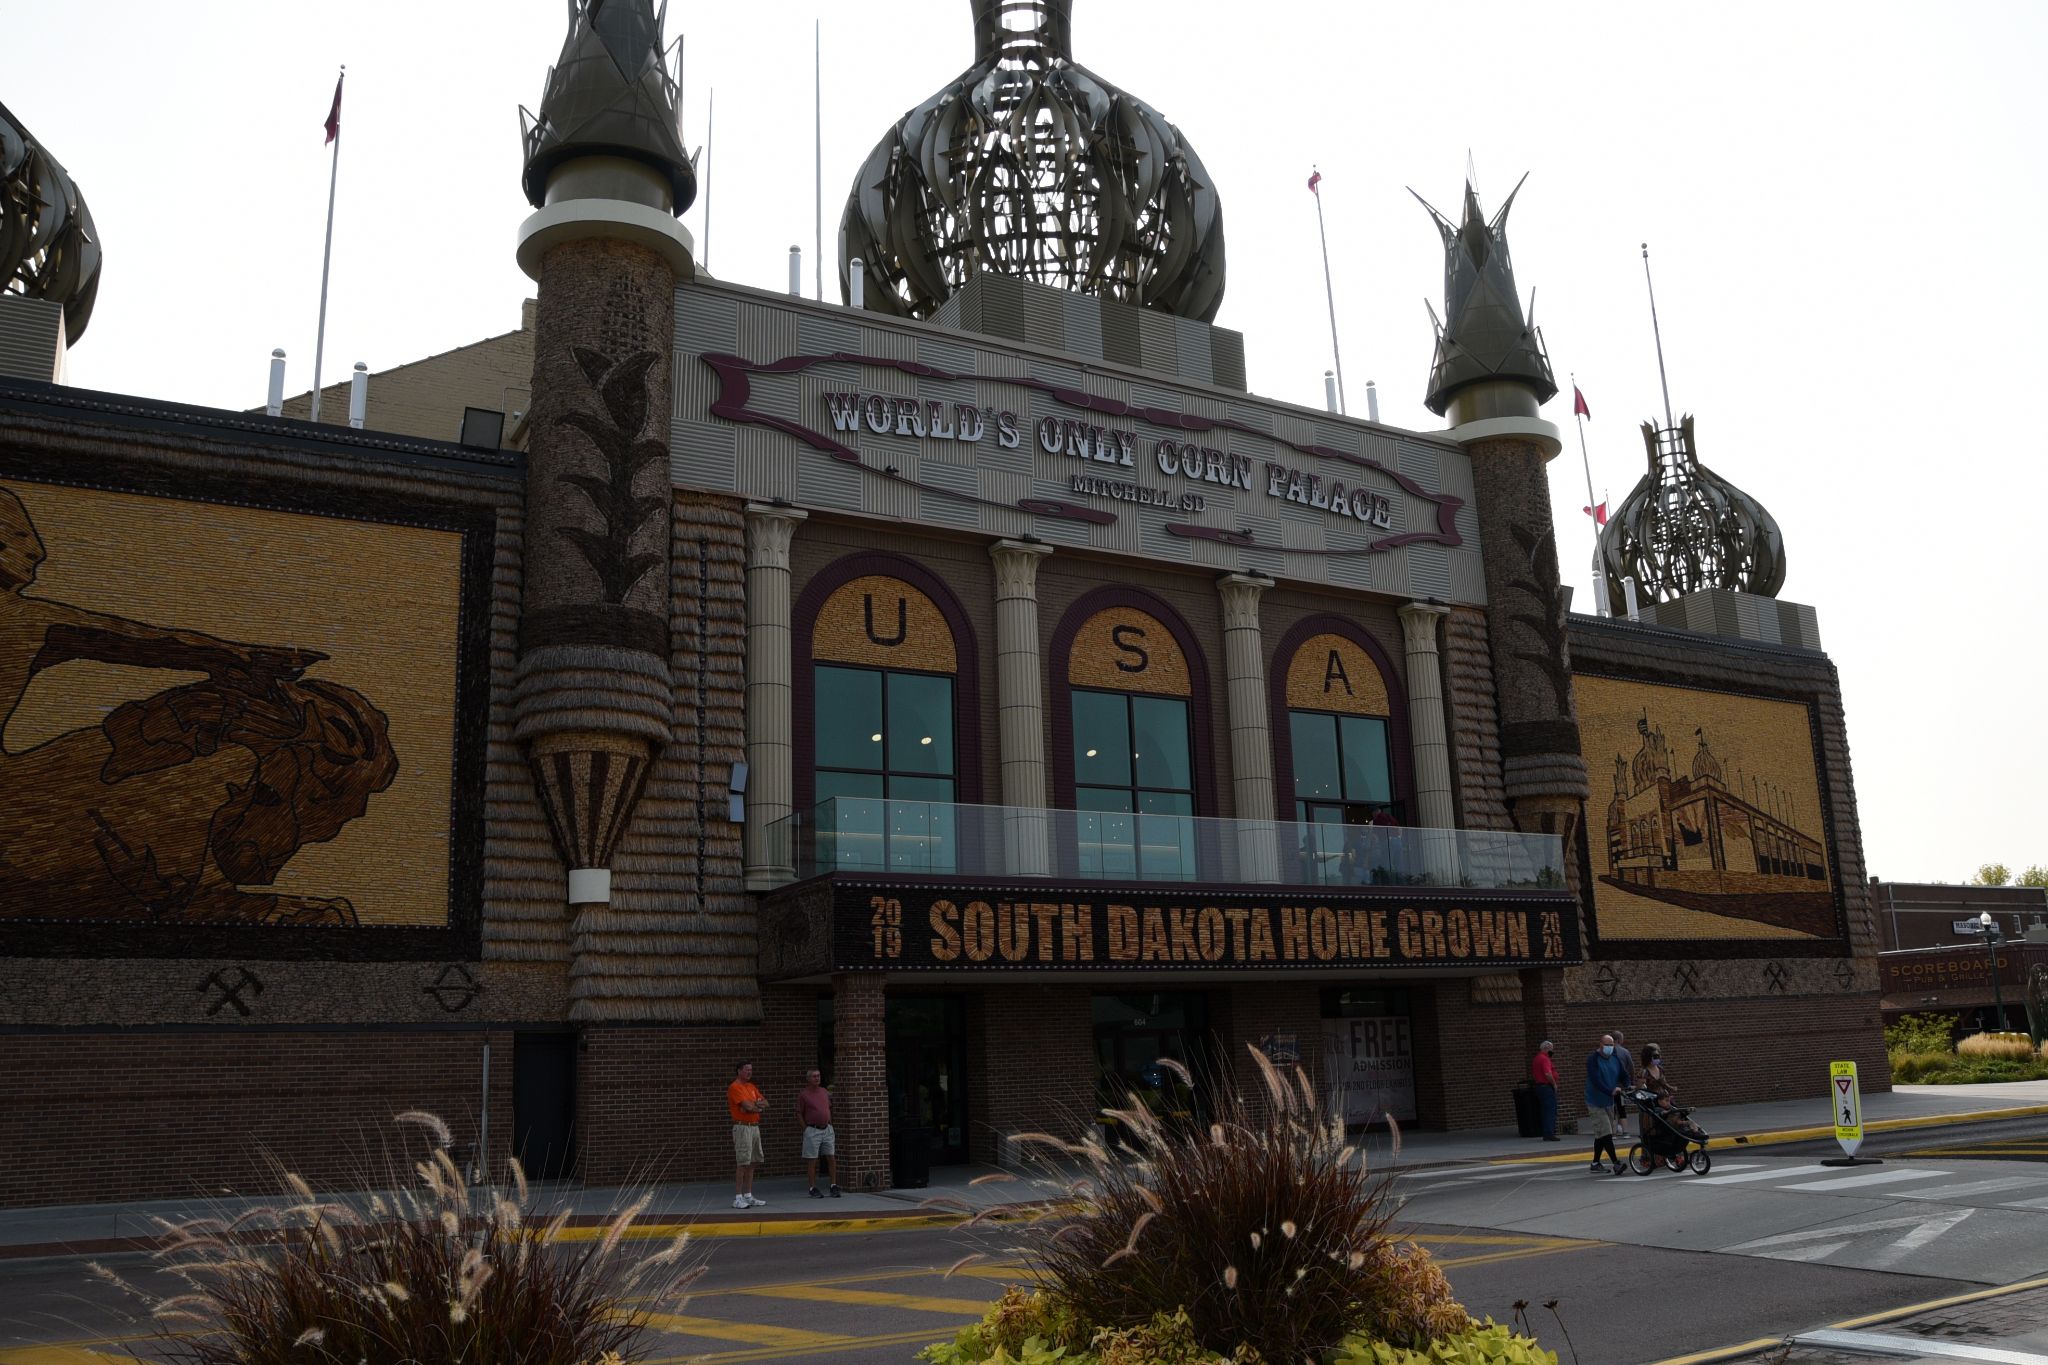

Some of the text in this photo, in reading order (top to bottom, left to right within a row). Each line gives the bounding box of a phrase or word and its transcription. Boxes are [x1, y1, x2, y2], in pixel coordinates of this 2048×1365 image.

[823, 391, 1392, 530] WORLD'S ONLY CORN PALACE
[1071, 474, 1208, 513] MITCHELL, SD
[864, 594, 1354, 696] U S A
[870, 896, 901, 926] 20
[1540, 911, 1561, 936] 20
[872, 926, 901, 959] 19
[929, 899, 1530, 962] SOUTH DAKOTA HOME GROWN
[1543, 936, 1564, 959] 20
[1890, 958, 2008, 977] SCOREBOARD
[1350, 1018, 1410, 1059] FREE
[1353, 1059, 1411, 1072] ADMISSION
